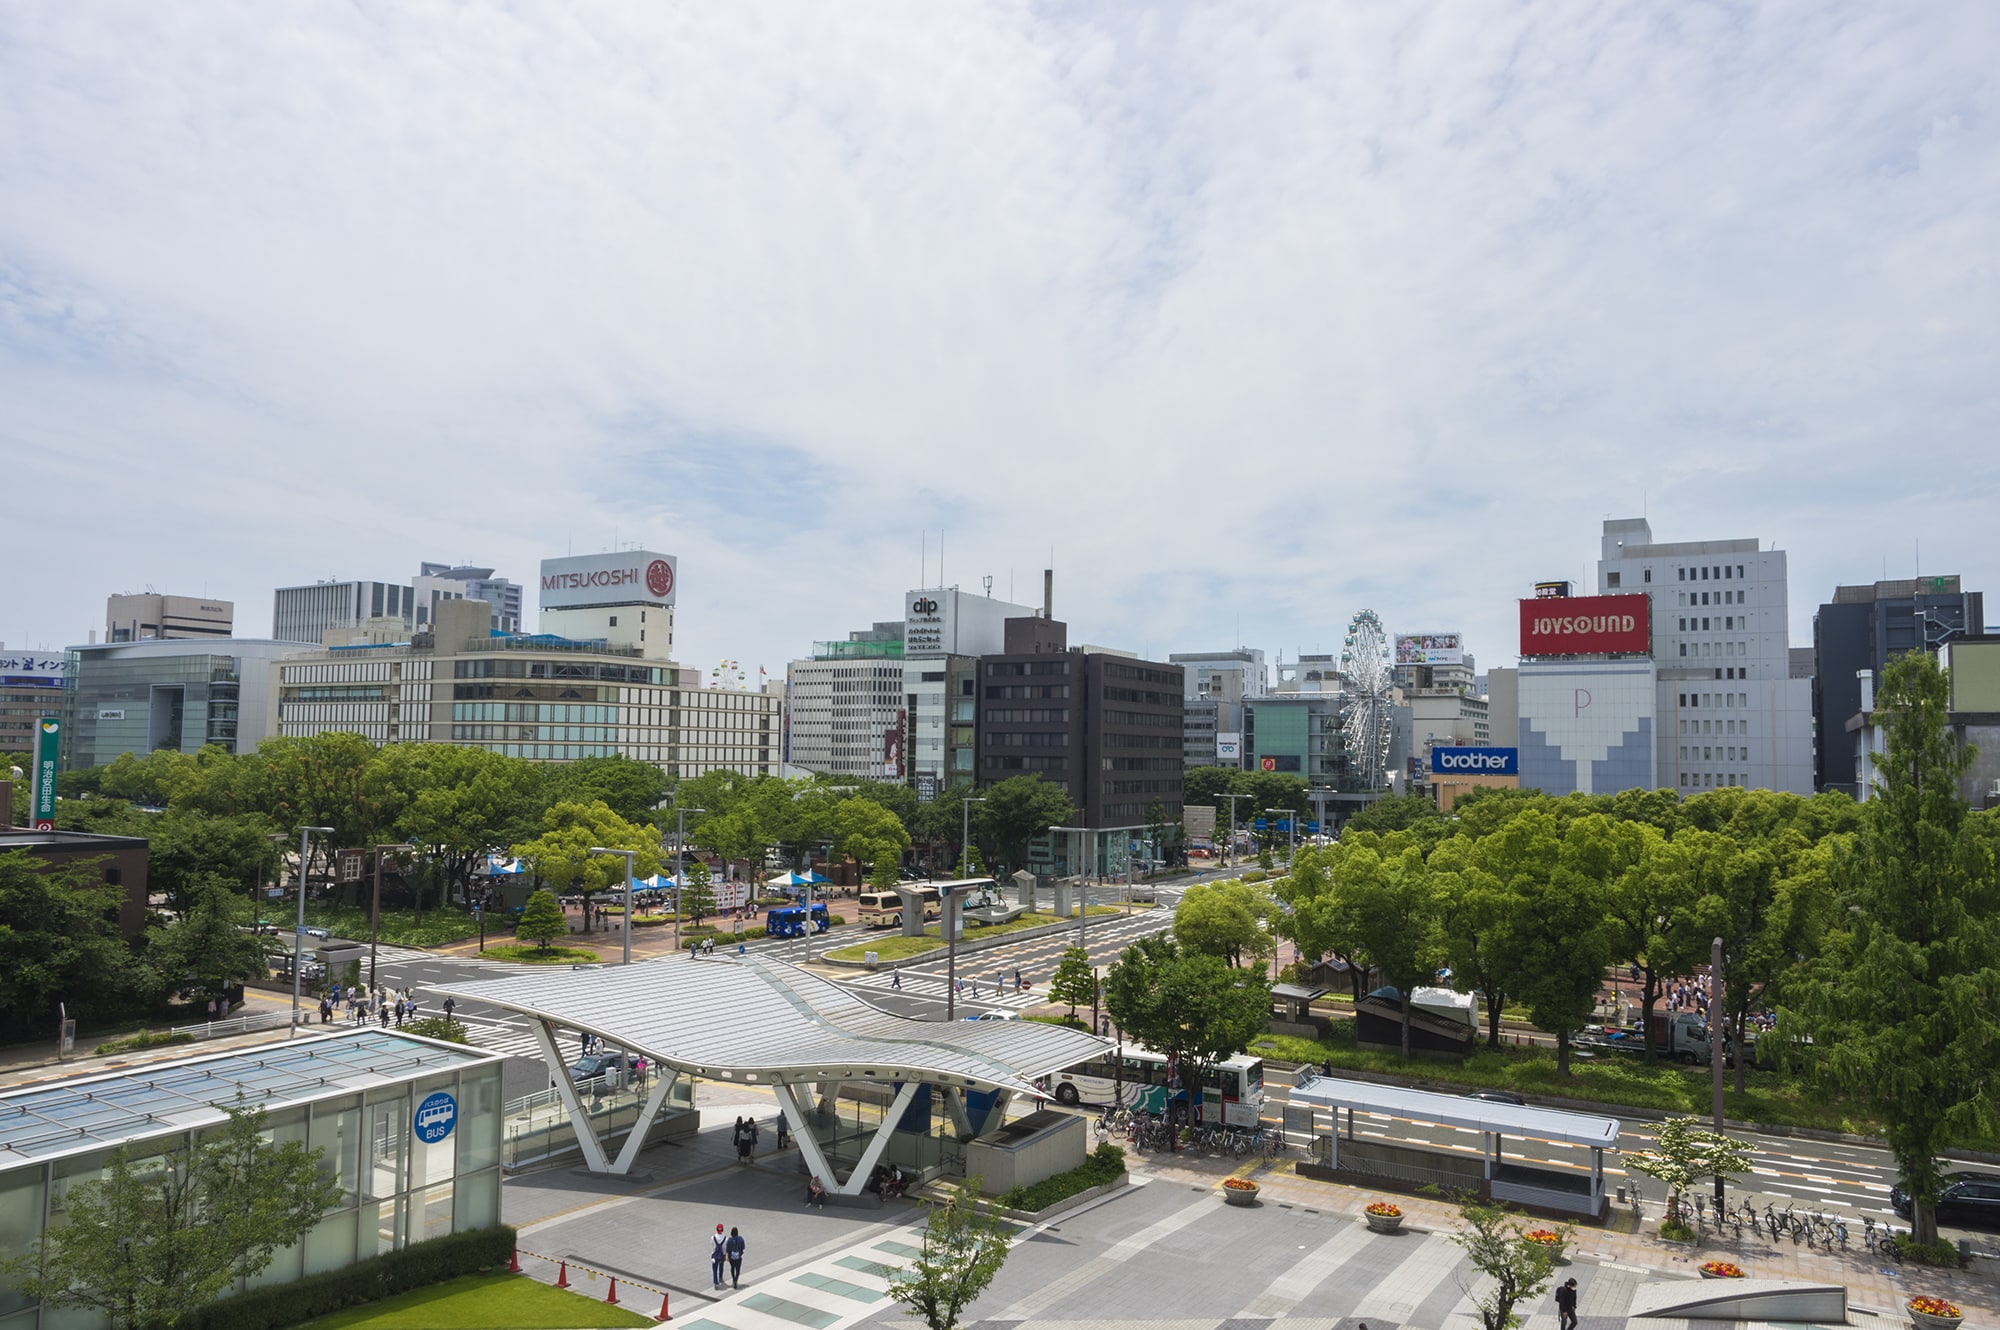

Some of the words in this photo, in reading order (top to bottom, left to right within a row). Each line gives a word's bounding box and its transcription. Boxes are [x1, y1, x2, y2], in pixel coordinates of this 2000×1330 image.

[542, 568, 638, 590] MITSUKOSHI
[913, 597, 937, 616] dip
[1532, 615, 1635, 635] JOYSOUND
[1441, 753, 1509, 768] brother
[426, 1126, 445, 1139] BUS
